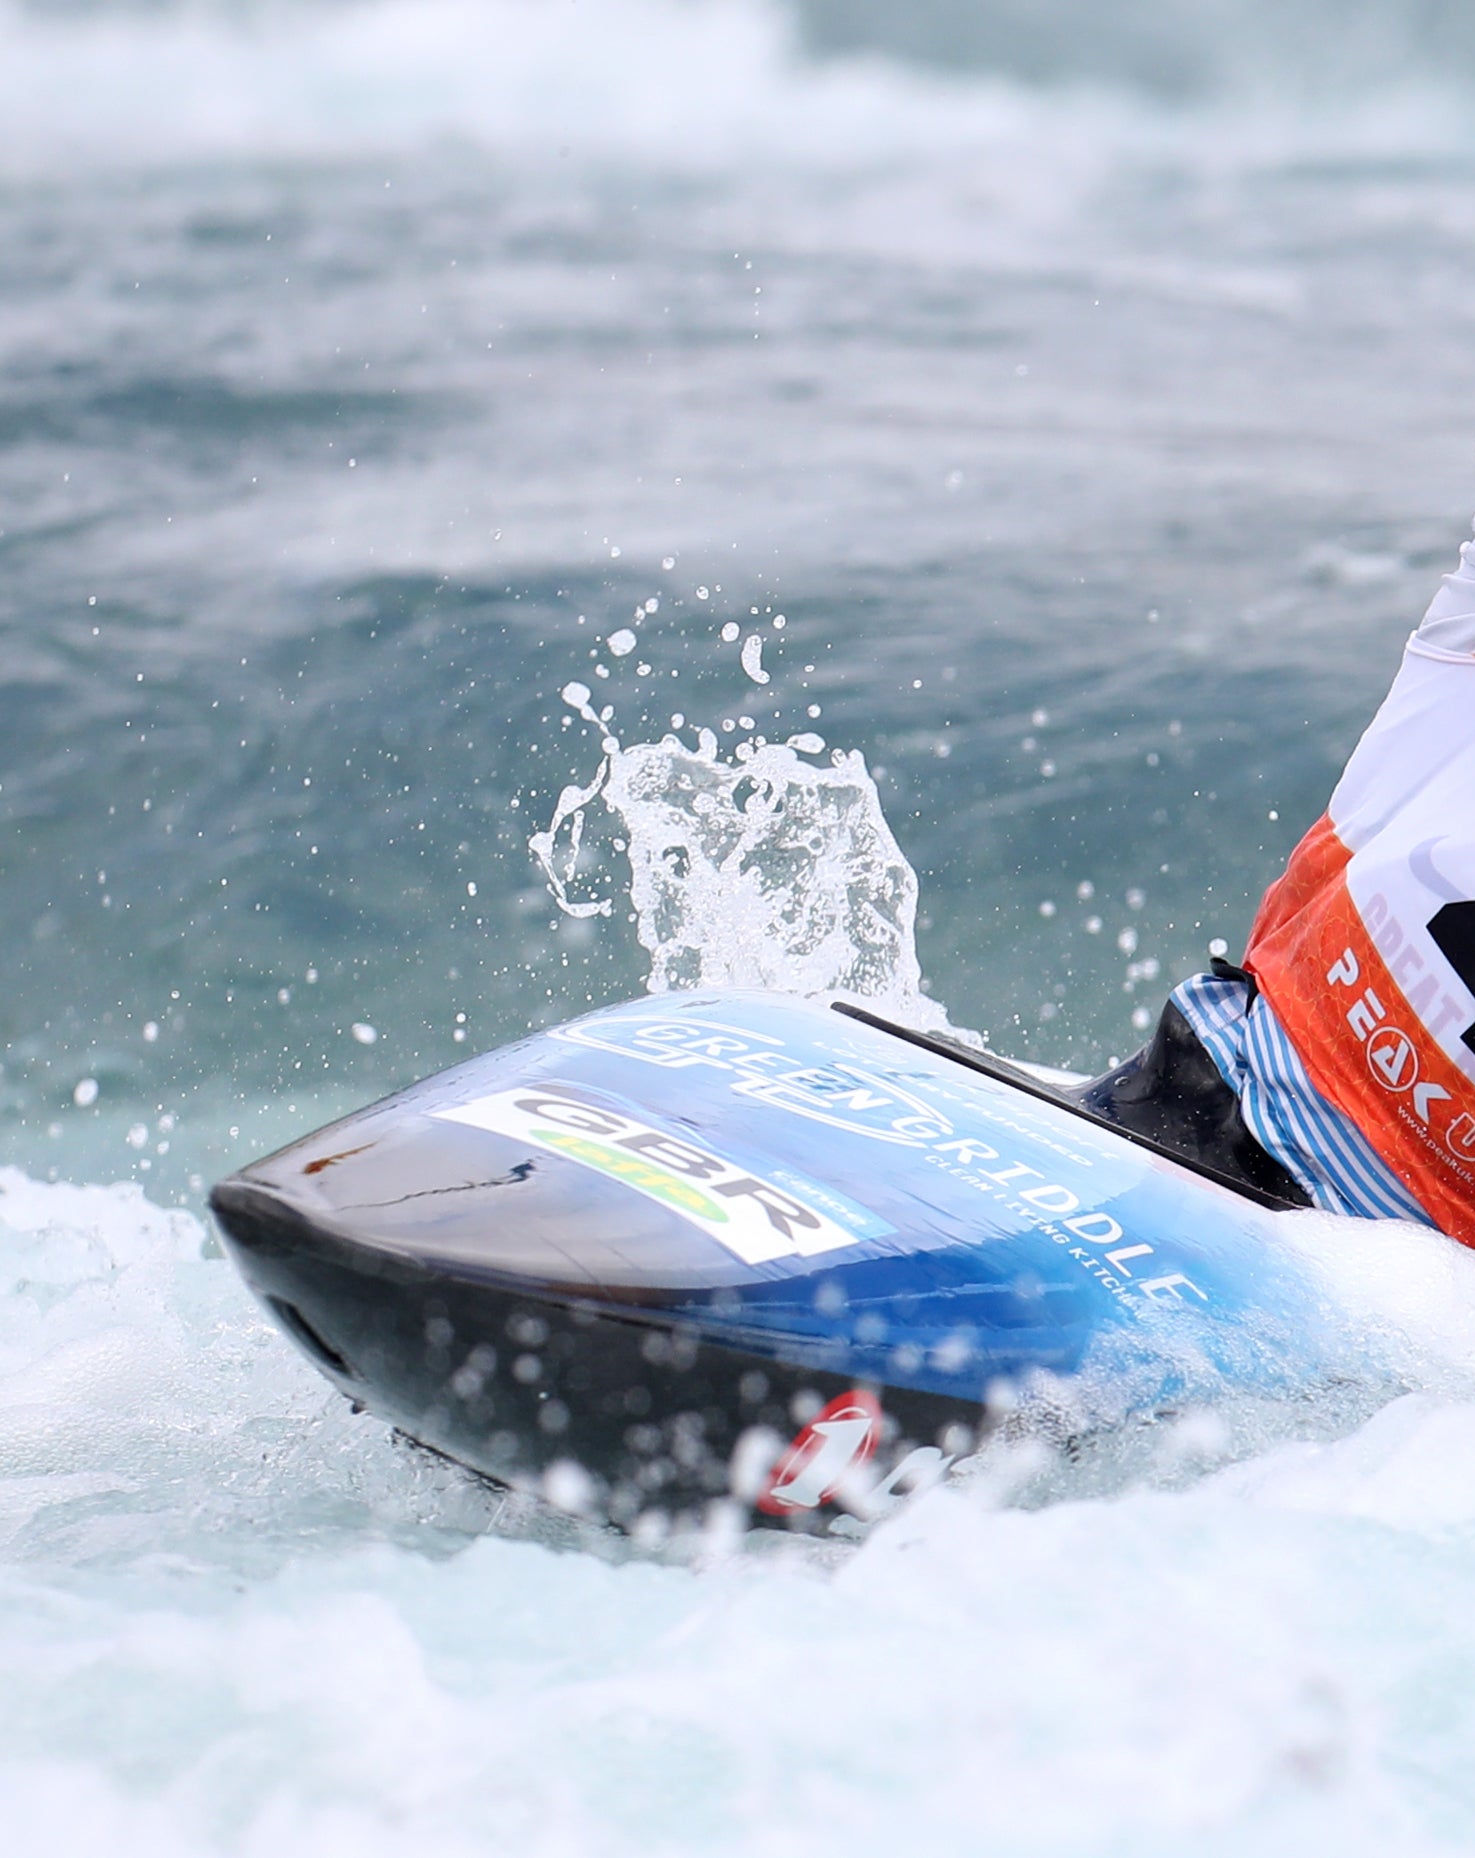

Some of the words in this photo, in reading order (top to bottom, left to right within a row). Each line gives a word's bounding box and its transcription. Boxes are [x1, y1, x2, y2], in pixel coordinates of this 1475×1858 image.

[513, 1098, 820, 1241] GBR
[635, 1024, 894, 1111] GREEN
[891, 1116, 1209, 1301] GRIDDLE
[924, 1154, 994, 1192] CLEAN
[962, 1102, 1094, 1167] FUNDED
